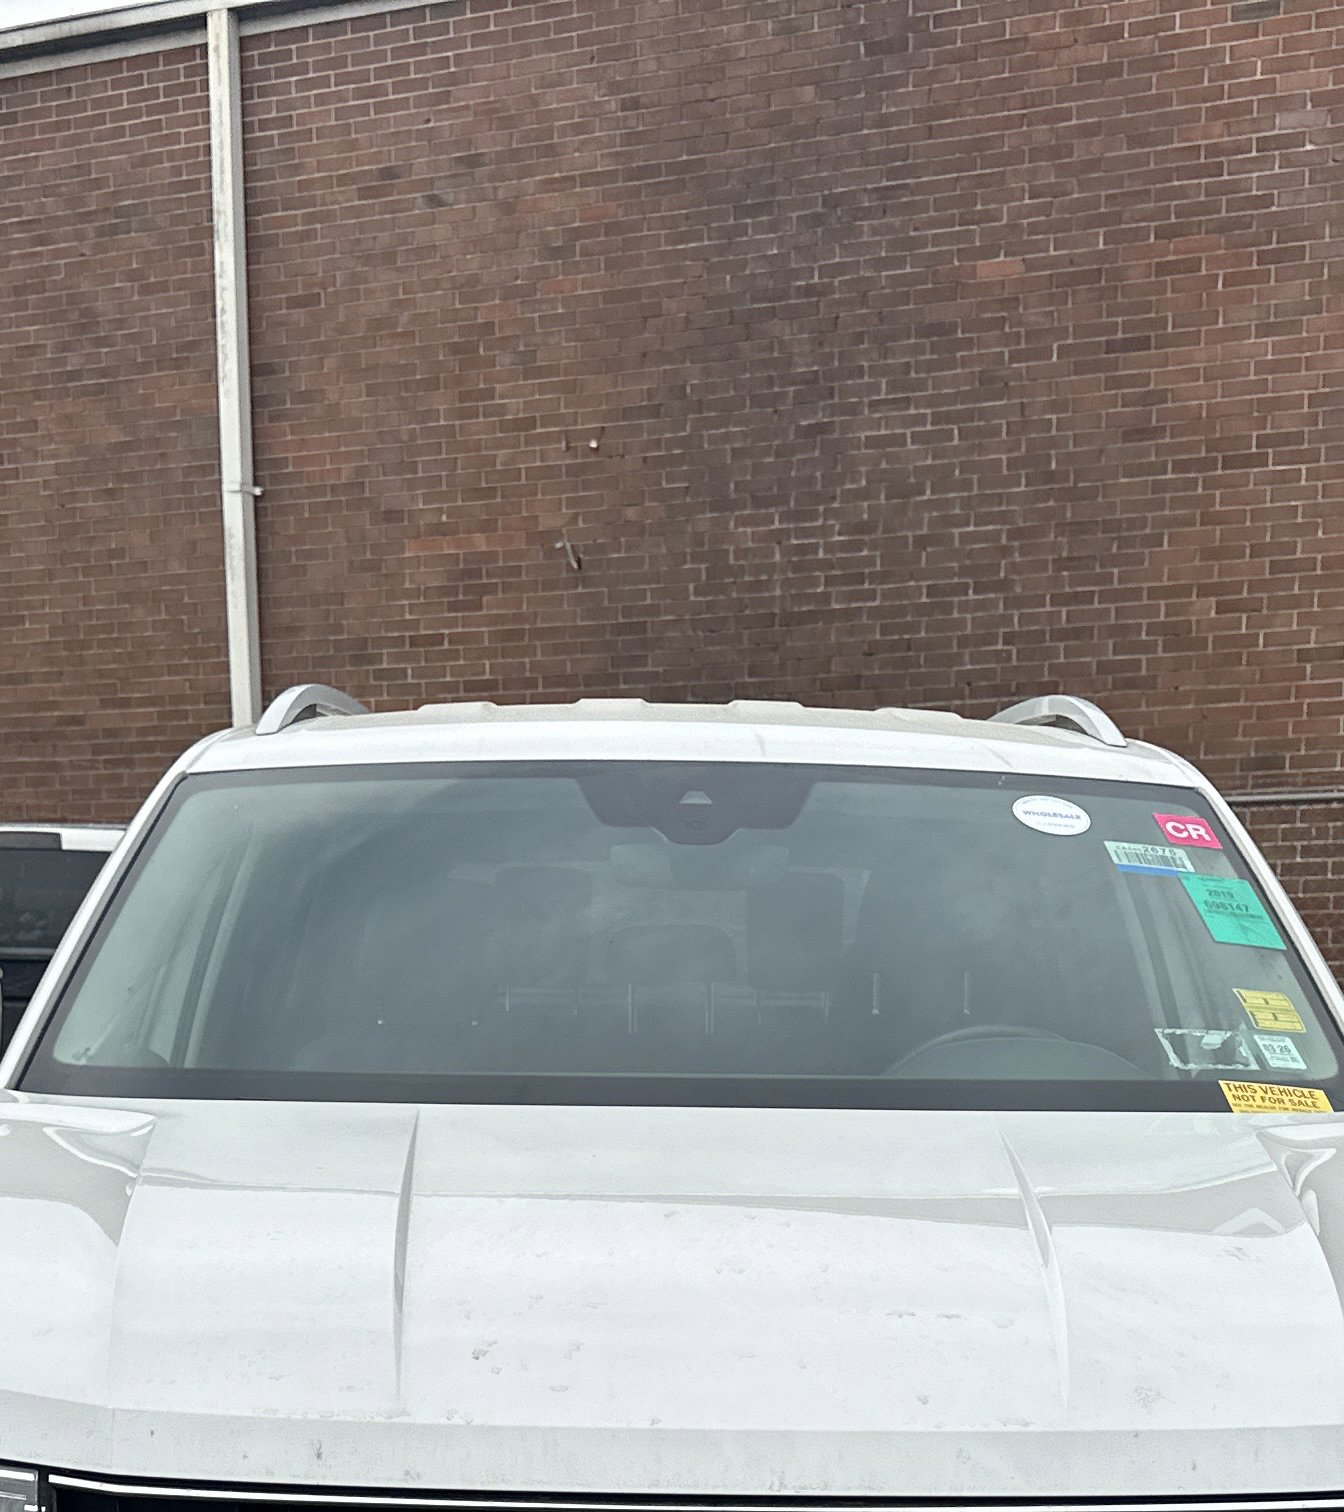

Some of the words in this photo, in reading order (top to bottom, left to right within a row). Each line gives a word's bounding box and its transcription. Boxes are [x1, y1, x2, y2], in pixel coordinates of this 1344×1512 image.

[1165, 821, 1211, 841] CR
[1224, 1082, 1258, 1093] THIS
[1258, 1085, 1319, 1100] VEHICLE
[1232, 1093, 1257, 1101] NOT
[1260, 1095, 1286, 1105] FOR
[1288, 1098, 1321, 1109] SALE
